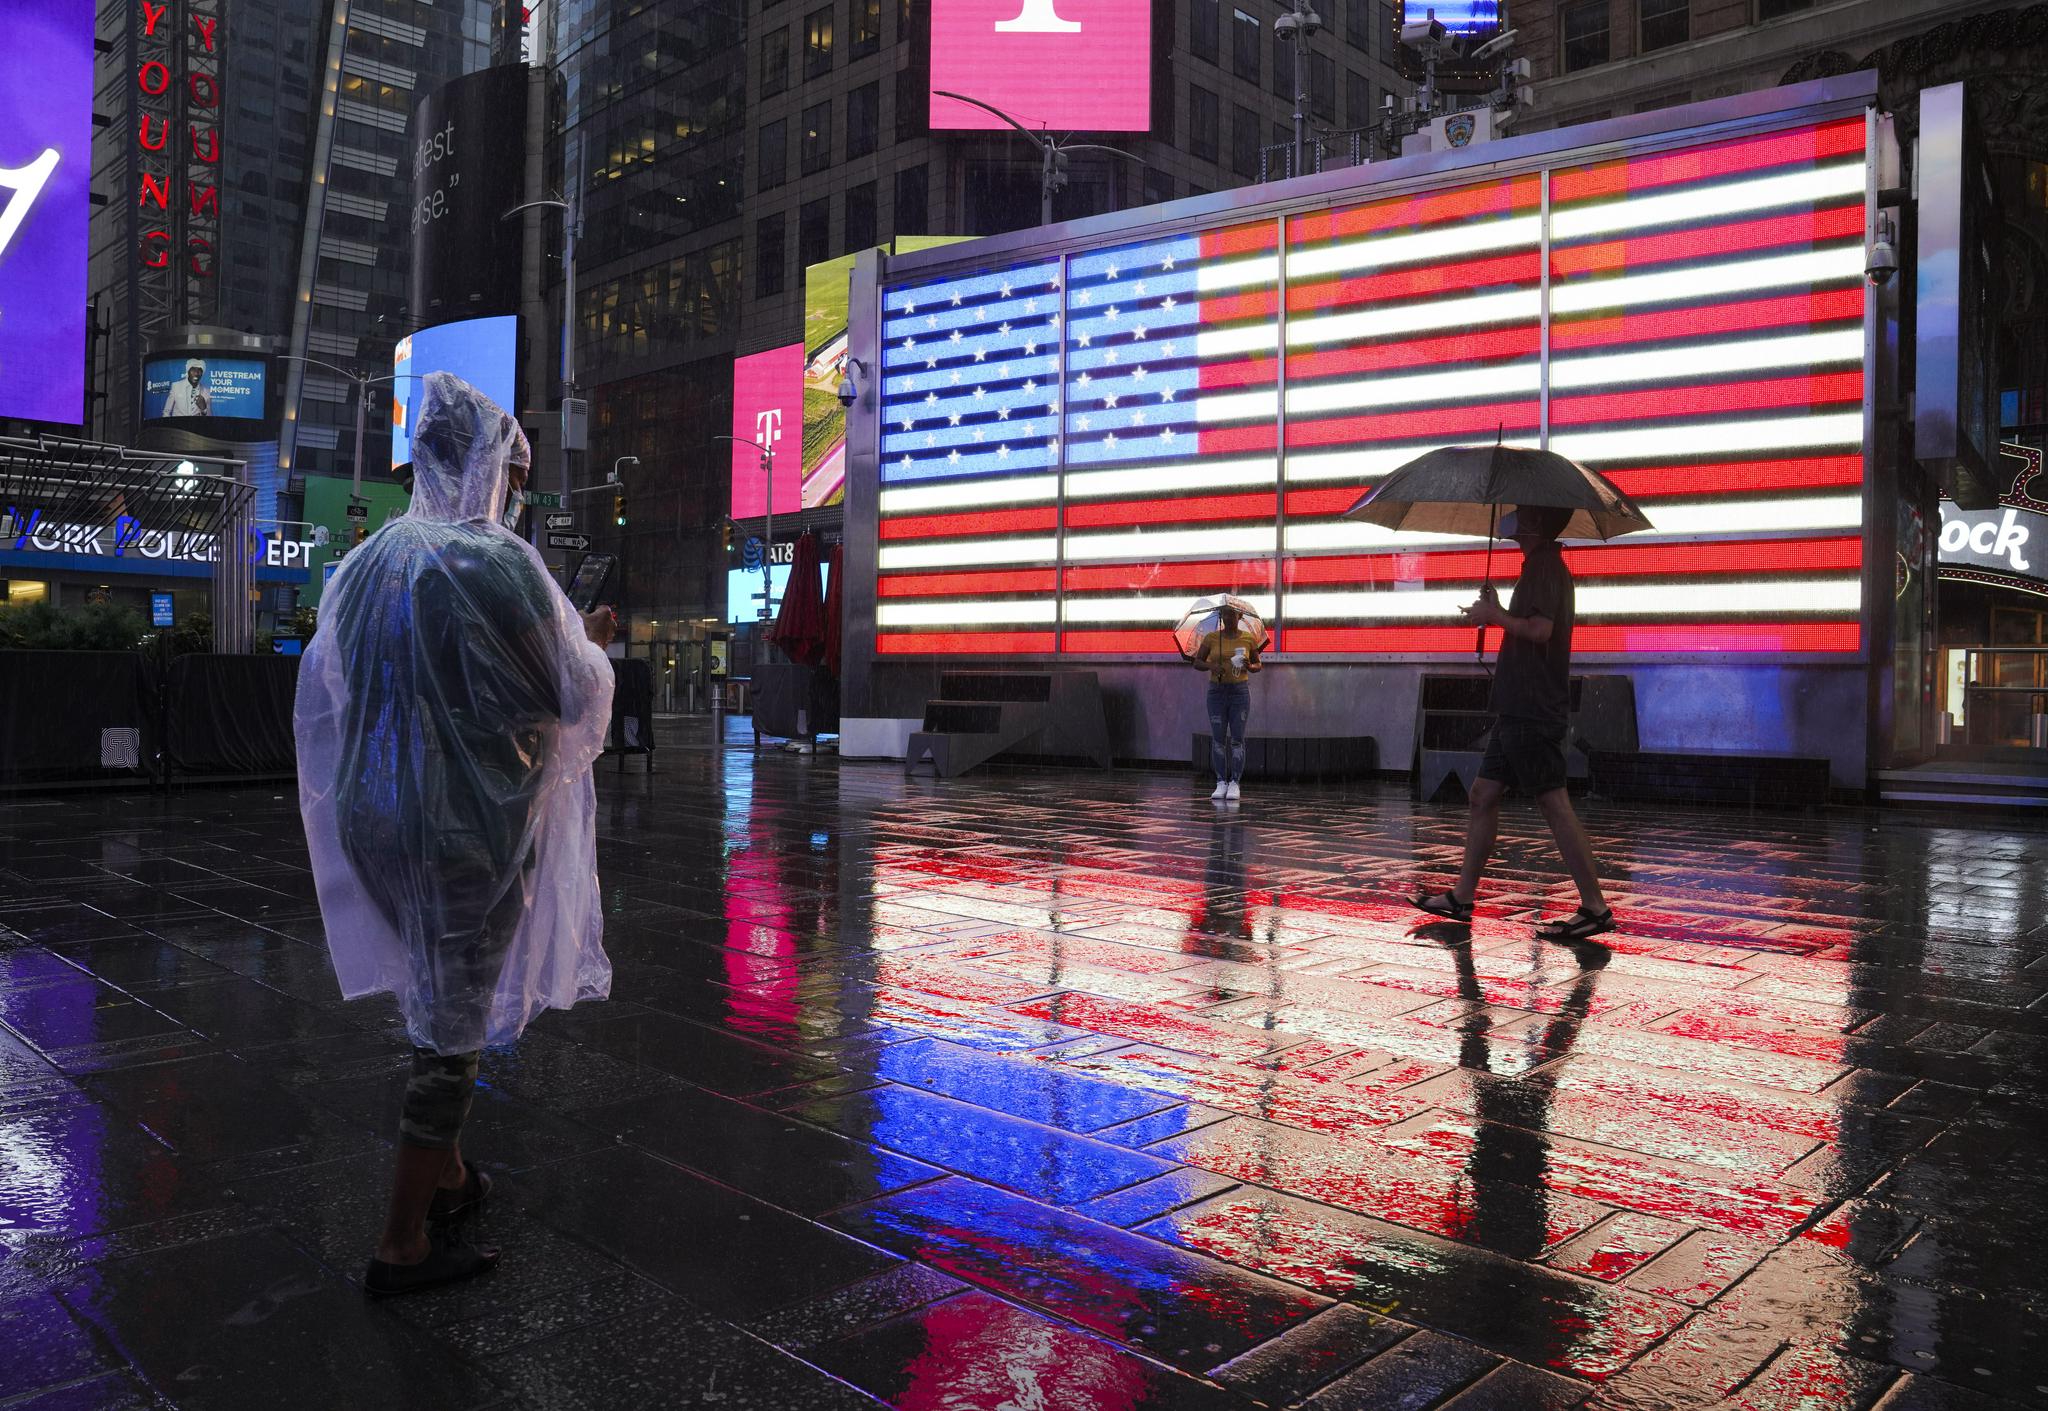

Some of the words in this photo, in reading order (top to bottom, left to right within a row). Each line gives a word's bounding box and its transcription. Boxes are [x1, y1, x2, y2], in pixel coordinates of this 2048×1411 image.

[139, 1, 170, 268] YOUNG
[210, 371, 261, 380] LIVESTREAM
[210, 378, 233, 386] YOUR
[209, 386, 251, 395] MOMENTS
[8, 505, 104, 555] YORK
[115, 515, 221, 563] POLICE
[553, 537, 567, 545] ONE
[571, 538, 585, 546] WAY
[1938, 508, 2031, 571] ock
